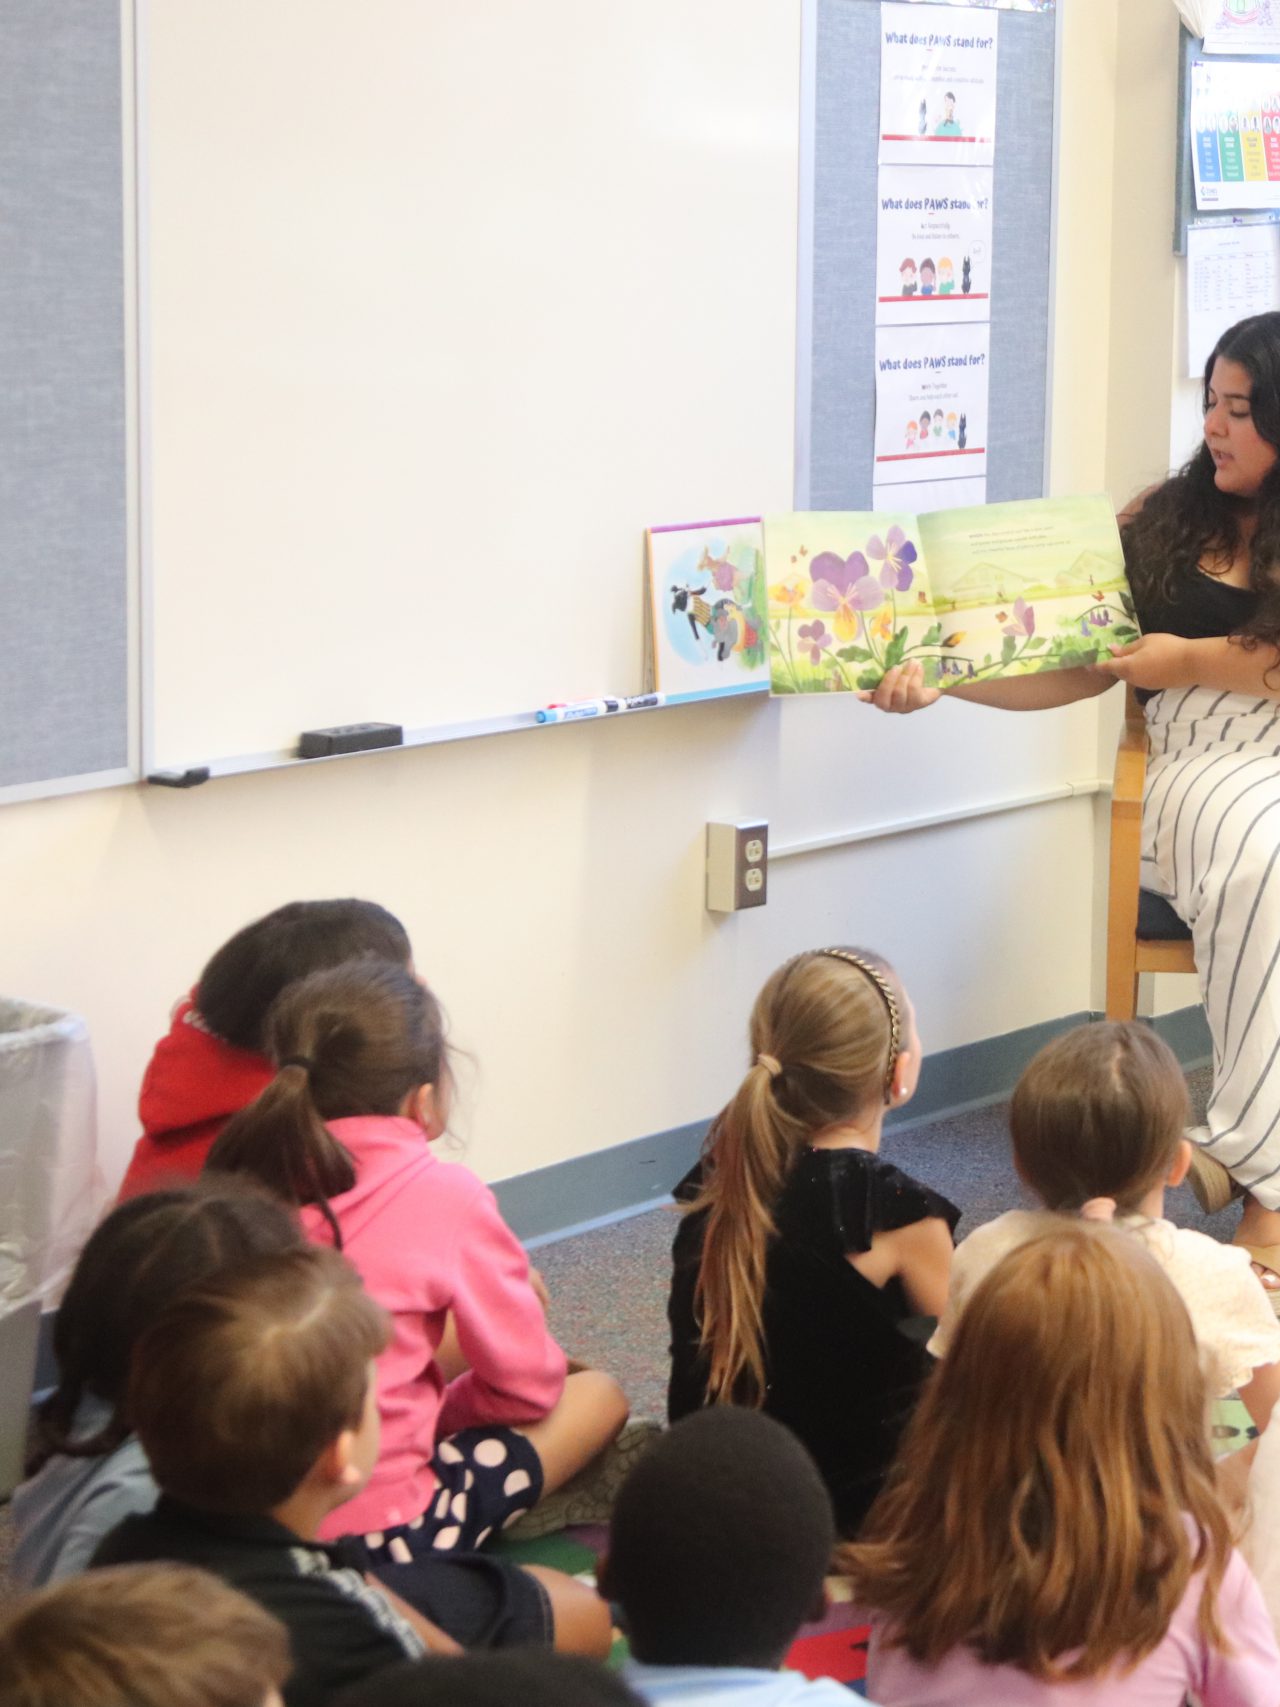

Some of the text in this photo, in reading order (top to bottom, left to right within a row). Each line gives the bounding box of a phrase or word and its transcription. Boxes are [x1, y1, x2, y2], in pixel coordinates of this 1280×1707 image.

[885, 32, 907, 44] What
[909, 33, 927, 45] does
[953, 37, 974, 48] stand
[976, 37, 993, 49] for?
[881, 197, 903, 210] What
[905, 198, 922, 210] does
[924, 198, 948, 210] PAWS
[879, 353, 985, 372] What does PAWS stand for?
